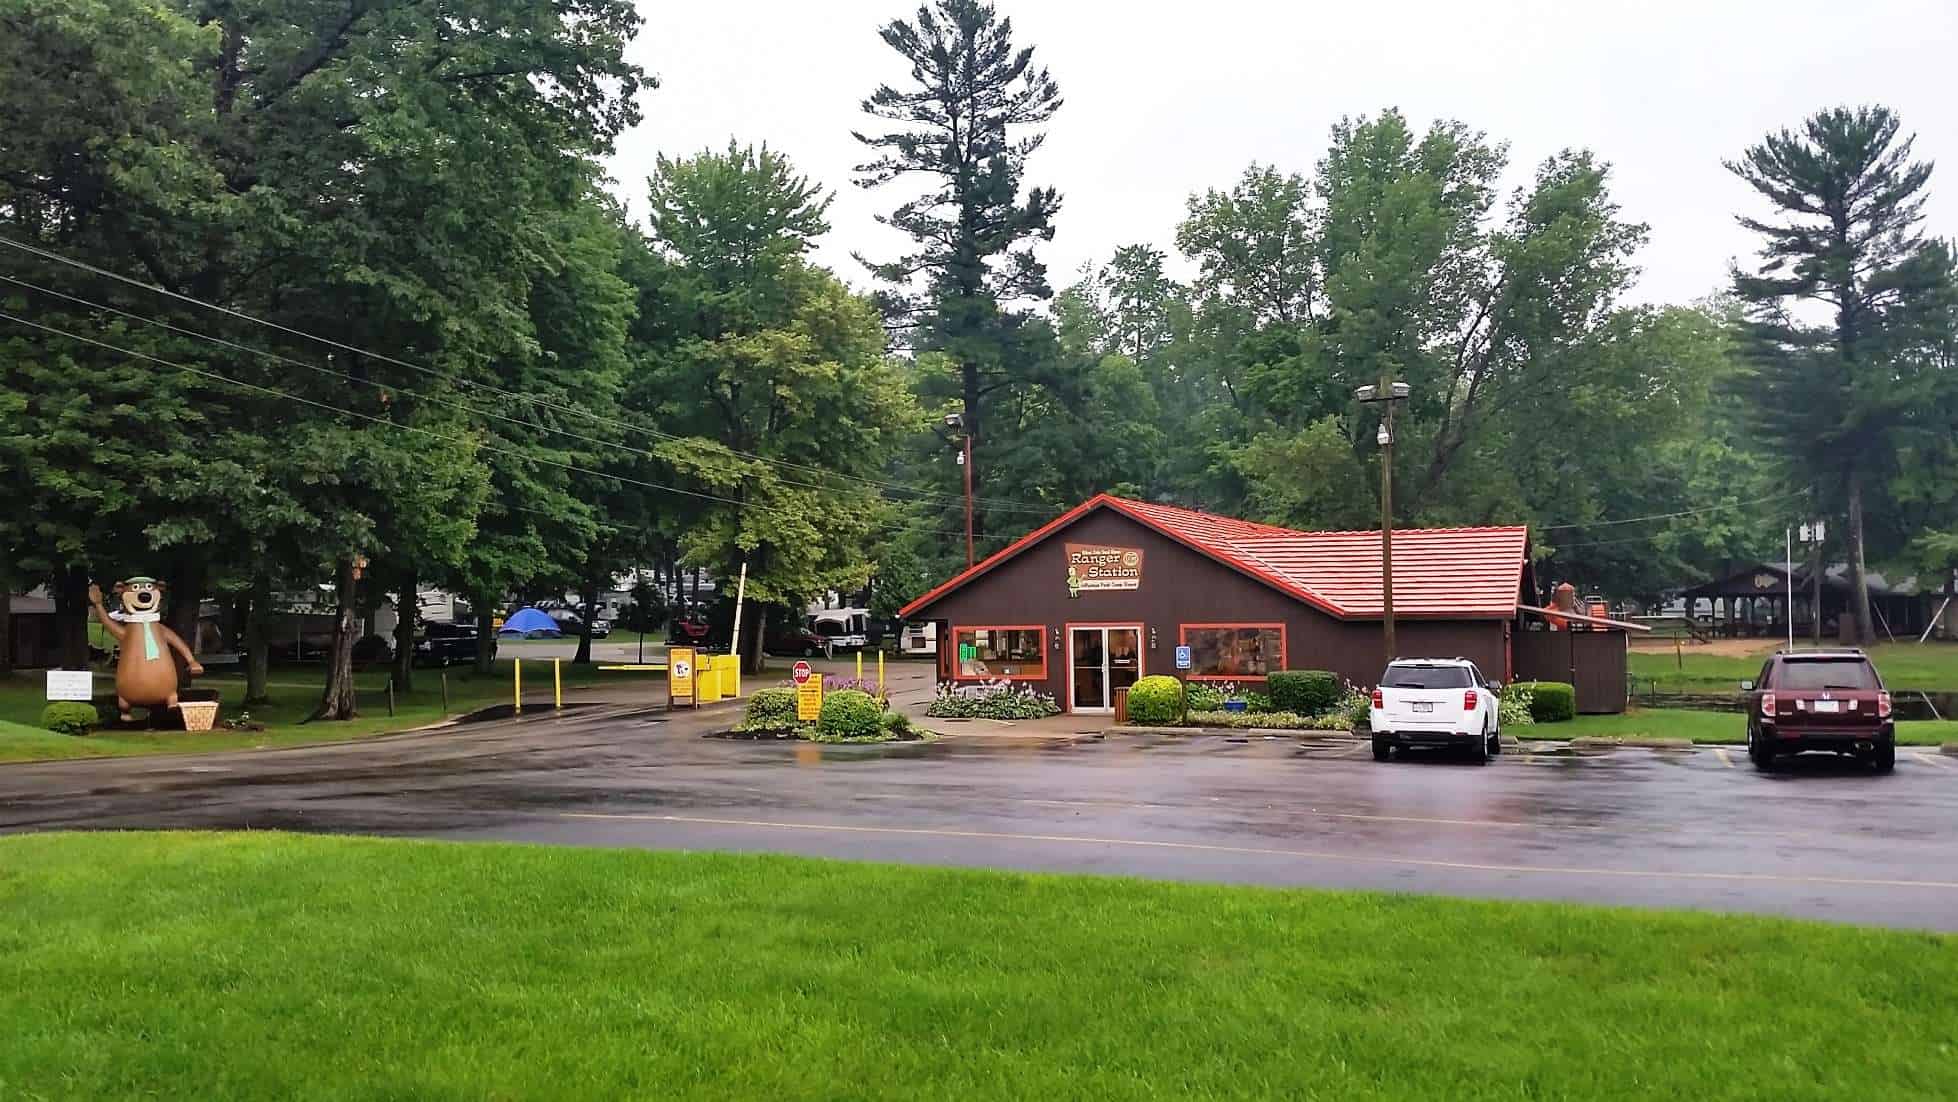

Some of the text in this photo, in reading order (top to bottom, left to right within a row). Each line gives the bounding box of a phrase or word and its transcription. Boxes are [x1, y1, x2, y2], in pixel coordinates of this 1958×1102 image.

[1071, 553, 1120, 566] Ranger
[1088, 566, 1138, 578] Station
[795, 668, 809, 677] STOP
